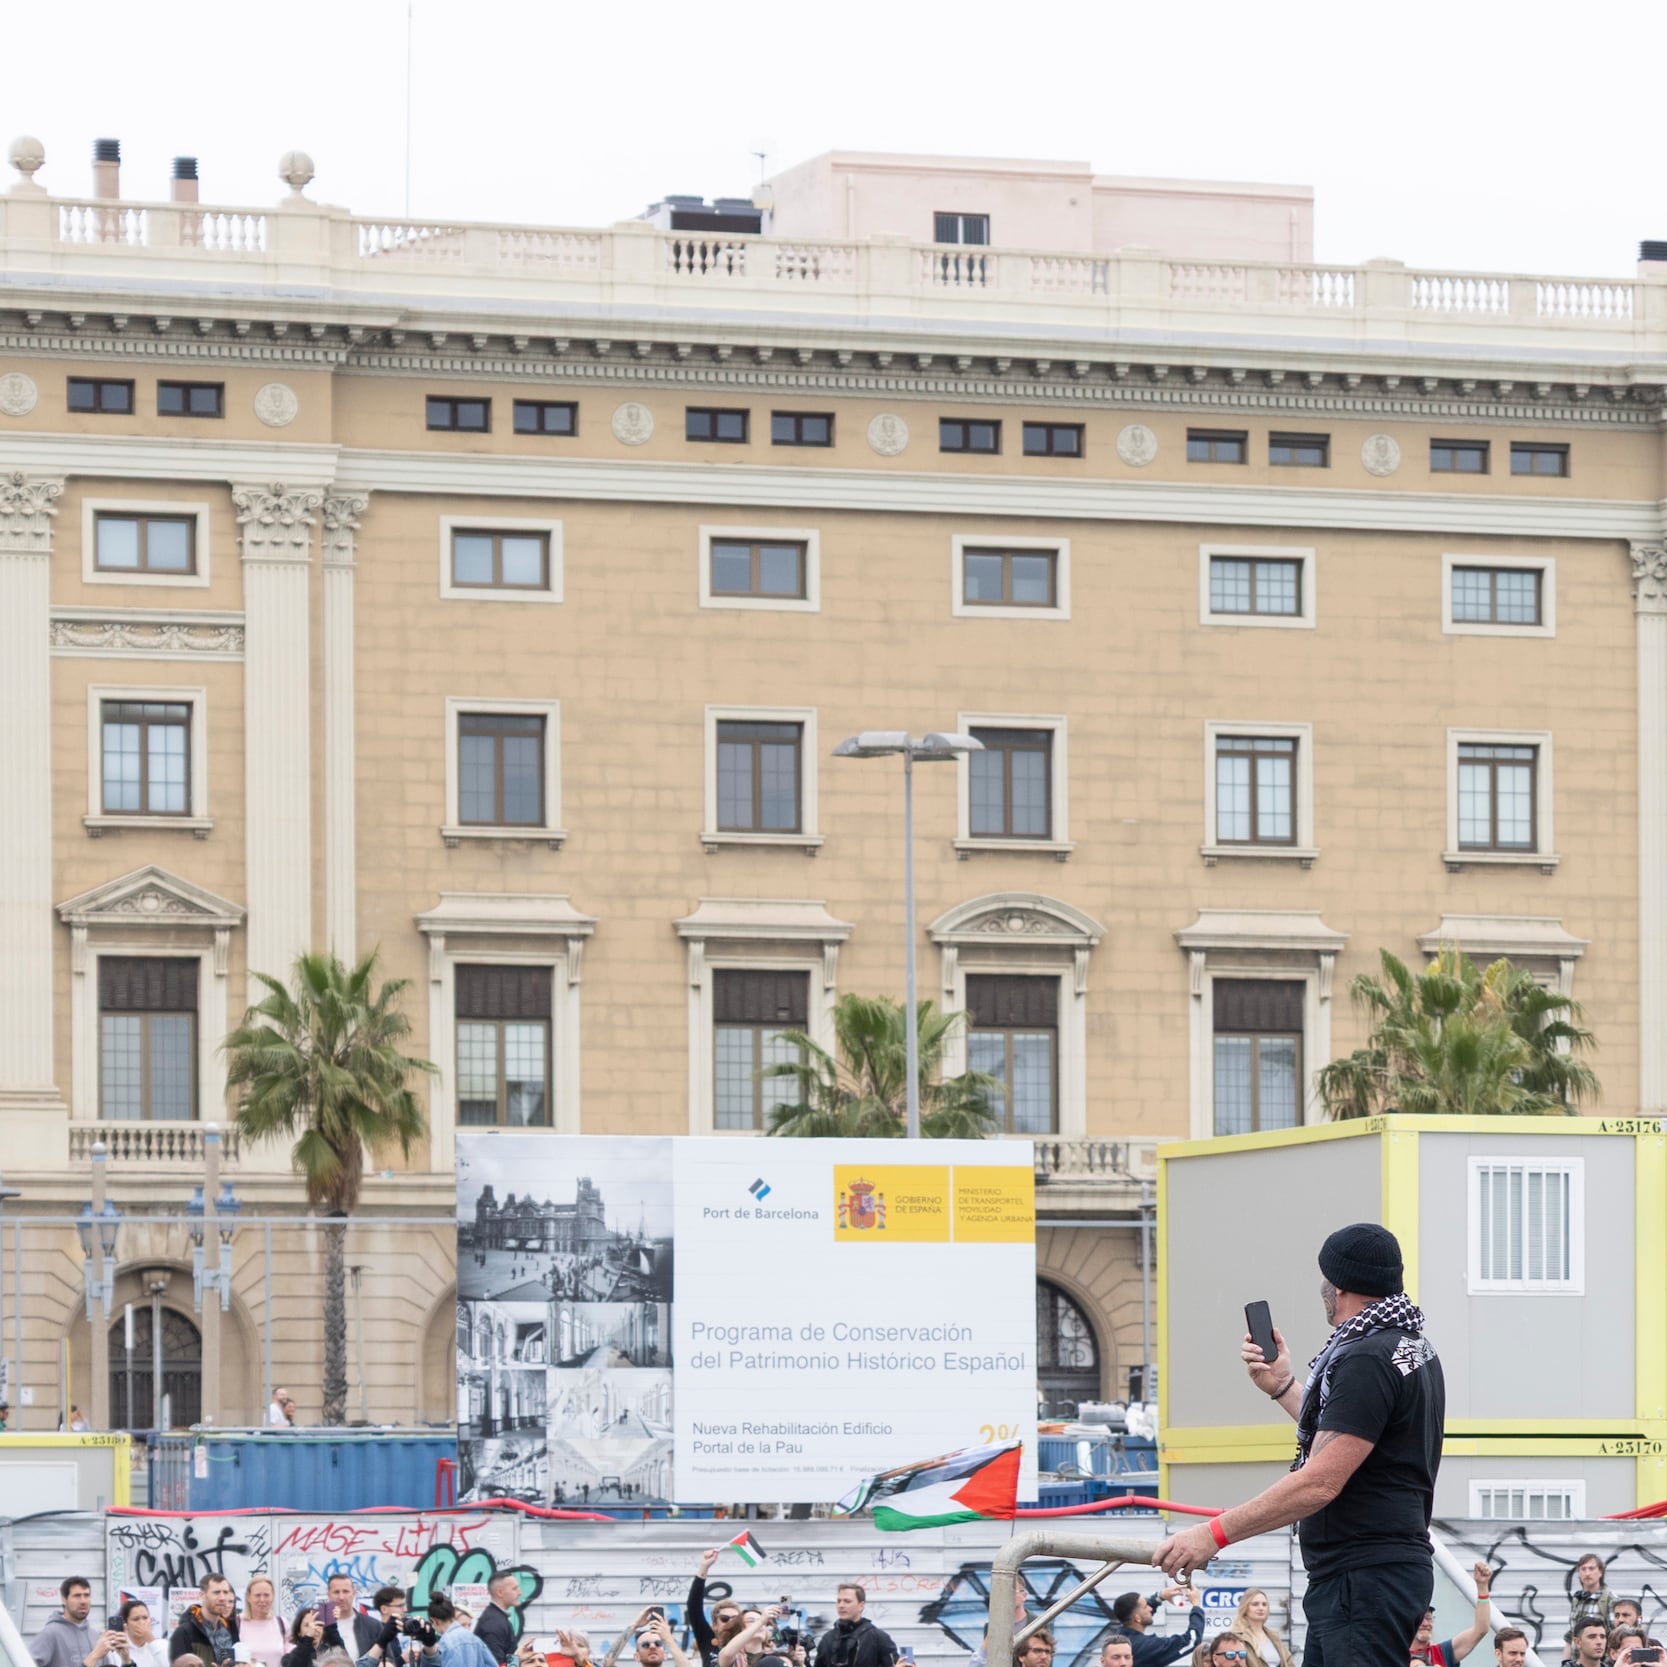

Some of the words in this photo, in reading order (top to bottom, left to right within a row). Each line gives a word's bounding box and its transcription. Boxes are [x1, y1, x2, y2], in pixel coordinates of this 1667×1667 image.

[895, 1196, 942, 1205] GOBIERNO
[703, 1207, 731, 1220] Port
[734, 1207, 751, 1219] de
[755, 1207, 819, 1220] Barcelona
[895, 1205, 907, 1214] DE
[908, 1203, 942, 1214] ESPAÑA
[691, 1322, 793, 1345] Programa
[800, 1322, 825, 1341] de
[832, 1322, 972, 1341] Conservación
[690, 1351, 721, 1369] del
[729, 1351, 840, 1369] Patrimonio
[848, 1351, 936, 1370] Histórico
[944, 1352, 1025, 1375] Español
[693, 1422, 738, 1435] Nueva
[742, 1421, 839, 1435] Rehabilitación
[843, 1422, 892, 1435] Edificio
[693, 1441, 733, 1454] Portal
[737, 1441, 754, 1454] de
[758, 1441, 771, 1454] la
[776, 1441, 803, 1454] Pau
